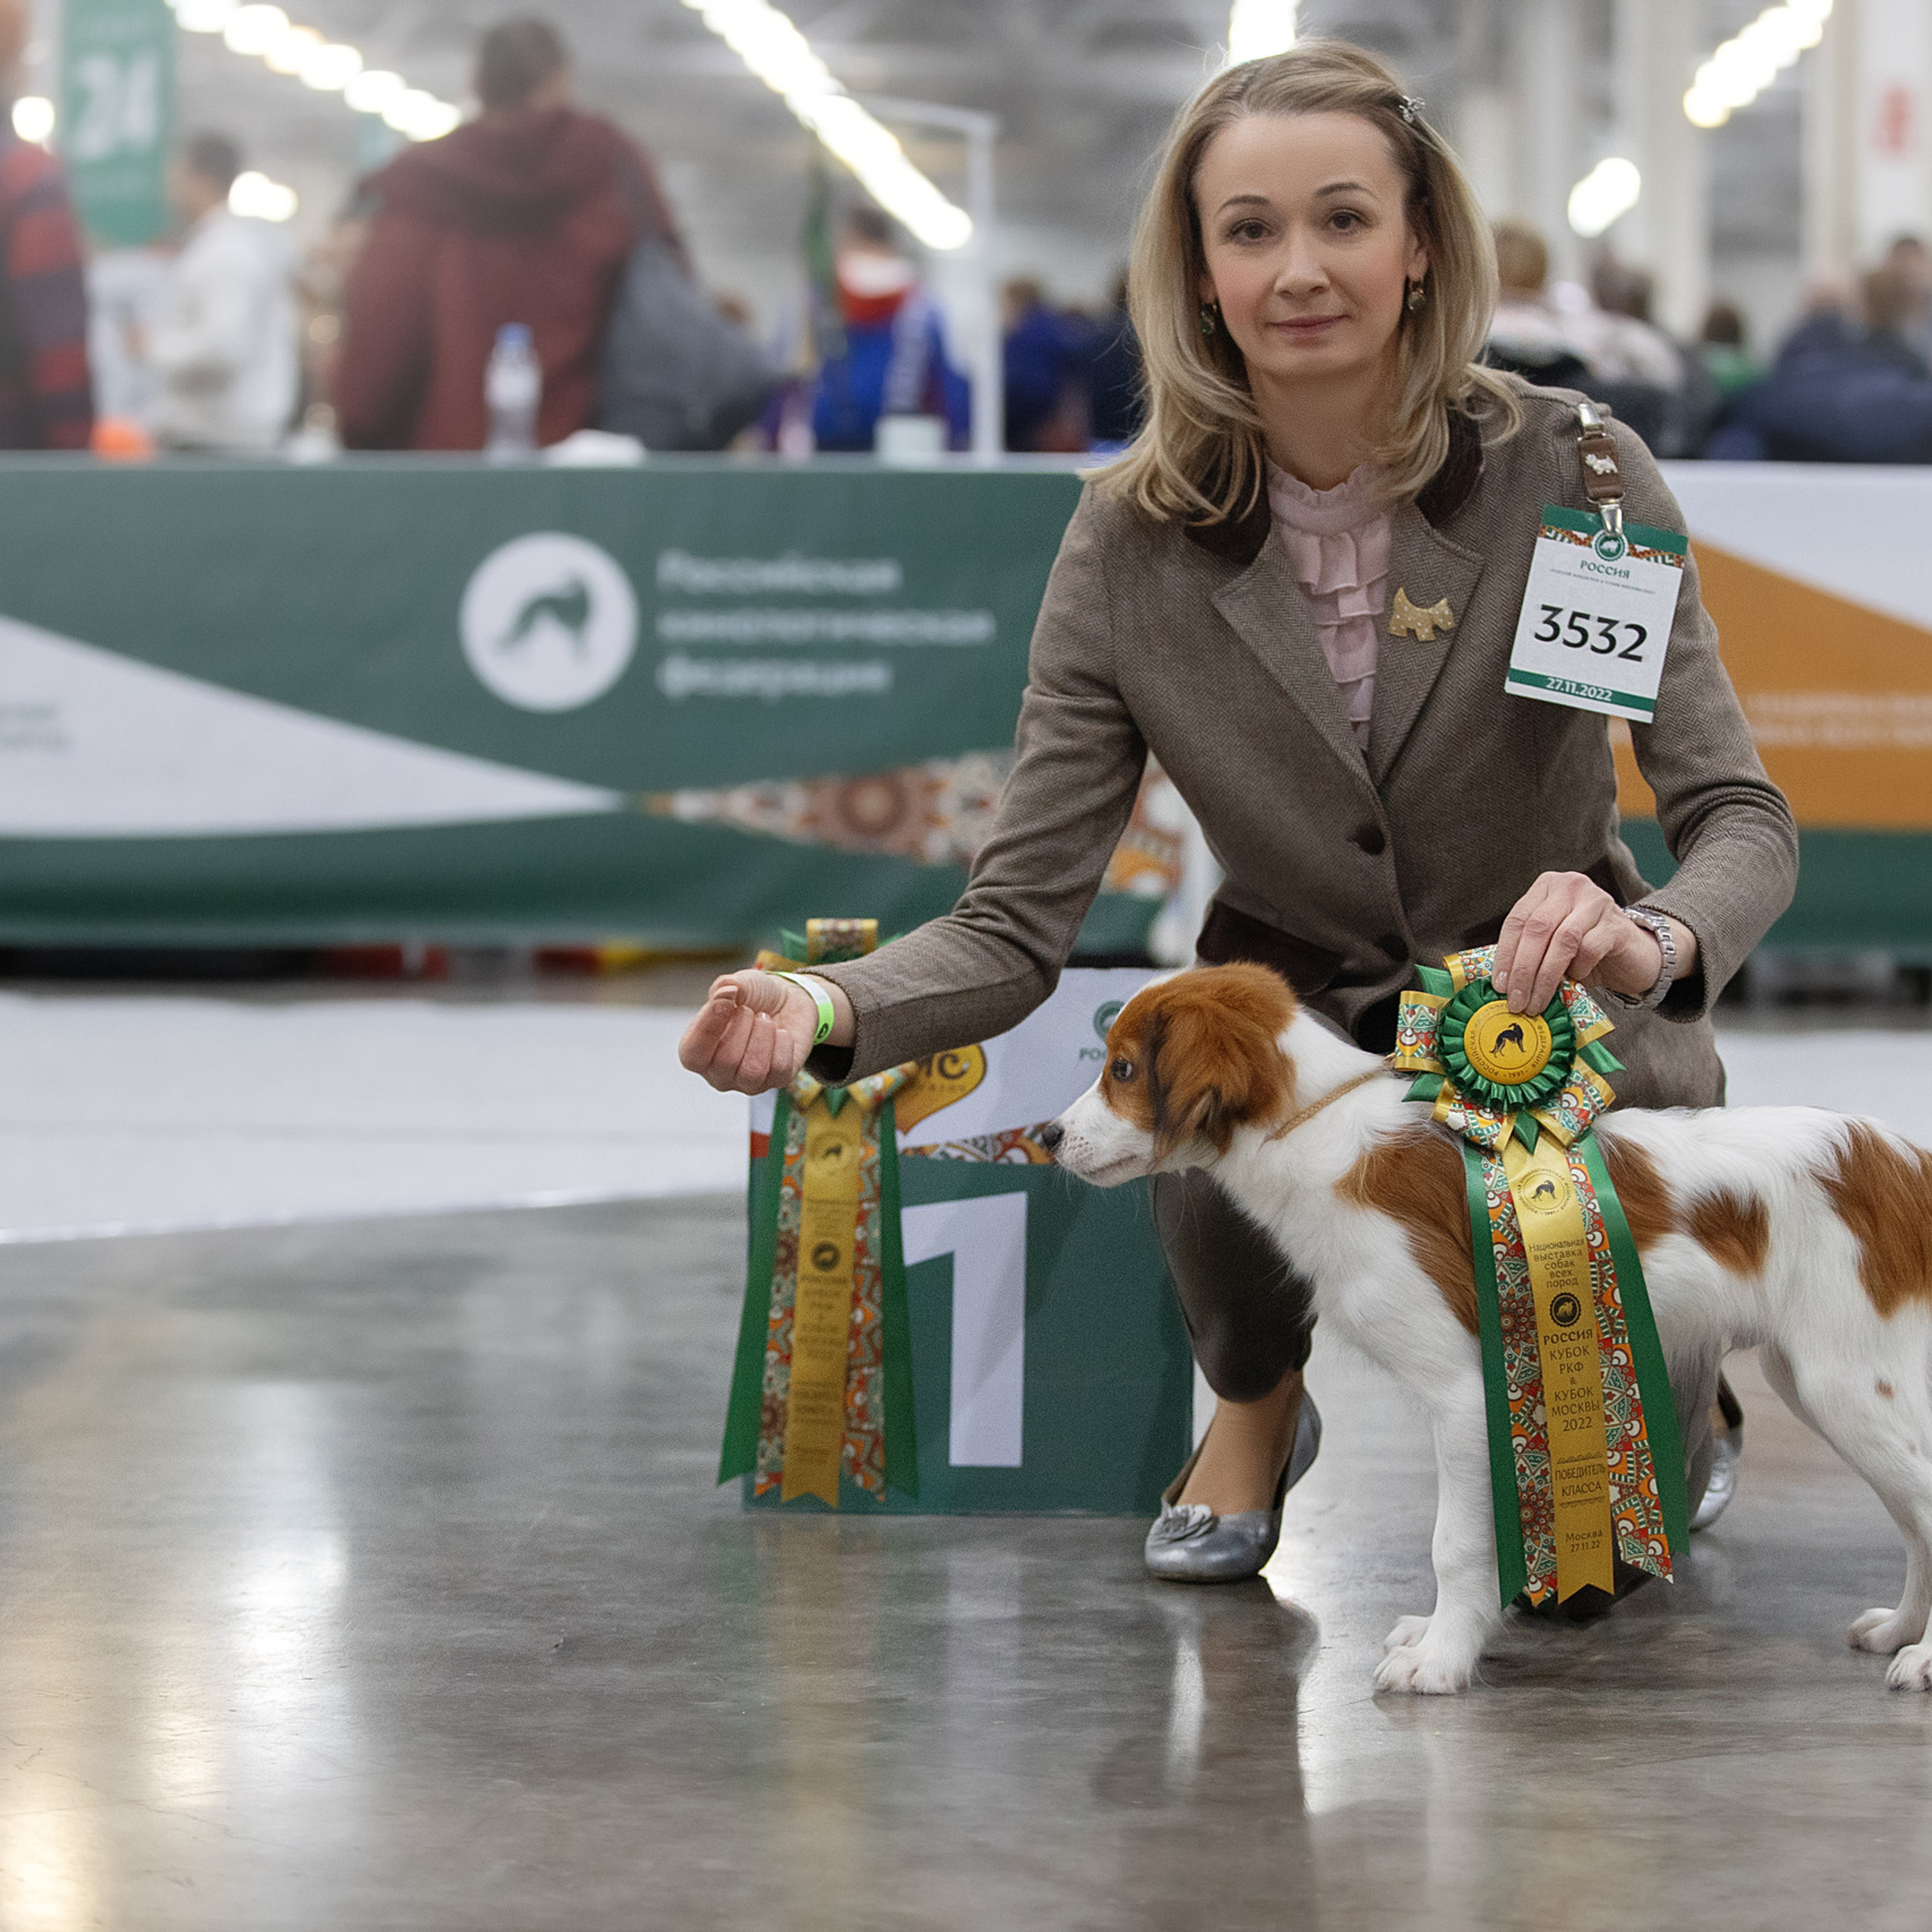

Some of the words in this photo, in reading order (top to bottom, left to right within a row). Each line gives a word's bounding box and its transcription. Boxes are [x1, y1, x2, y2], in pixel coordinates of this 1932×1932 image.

[73, 53, 158, 158] 24
[1580, 560, 1630, 579] РОССИЯ
[1534, 604, 1647, 662] 3532
[1546, 677, 1613, 702] 27.11.2022
[1529, 1238, 1584, 1253] Национальная
[1534, 1250, 1583, 1262] выставка
[1544, 1260, 1575, 1270] собак
[1549, 1270, 1573, 1278] всех
[1546, 1278, 1579, 1289] пород
[901, 1191, 1027, 1467] 1
[1543, 1329, 1593, 1346] РОССИЯ
[1550, 1346, 1589, 1361] КУБОК
[1559, 1361, 1584, 1375] РКФ
[1554, 1386, 1594, 1401] КУБОК
[1552, 1400, 1600, 1417] МОСКВЫ
[1563, 1417, 1592, 1432] 2022
[1555, 1464, 1606, 1481] ПОБЕДИТЕЛЬ
[1561, 1481, 1602, 1497] КЛАССА
[1565, 1531, 1603, 1542] Москва
[1571, 1540, 1601, 1552] 27.11.22
